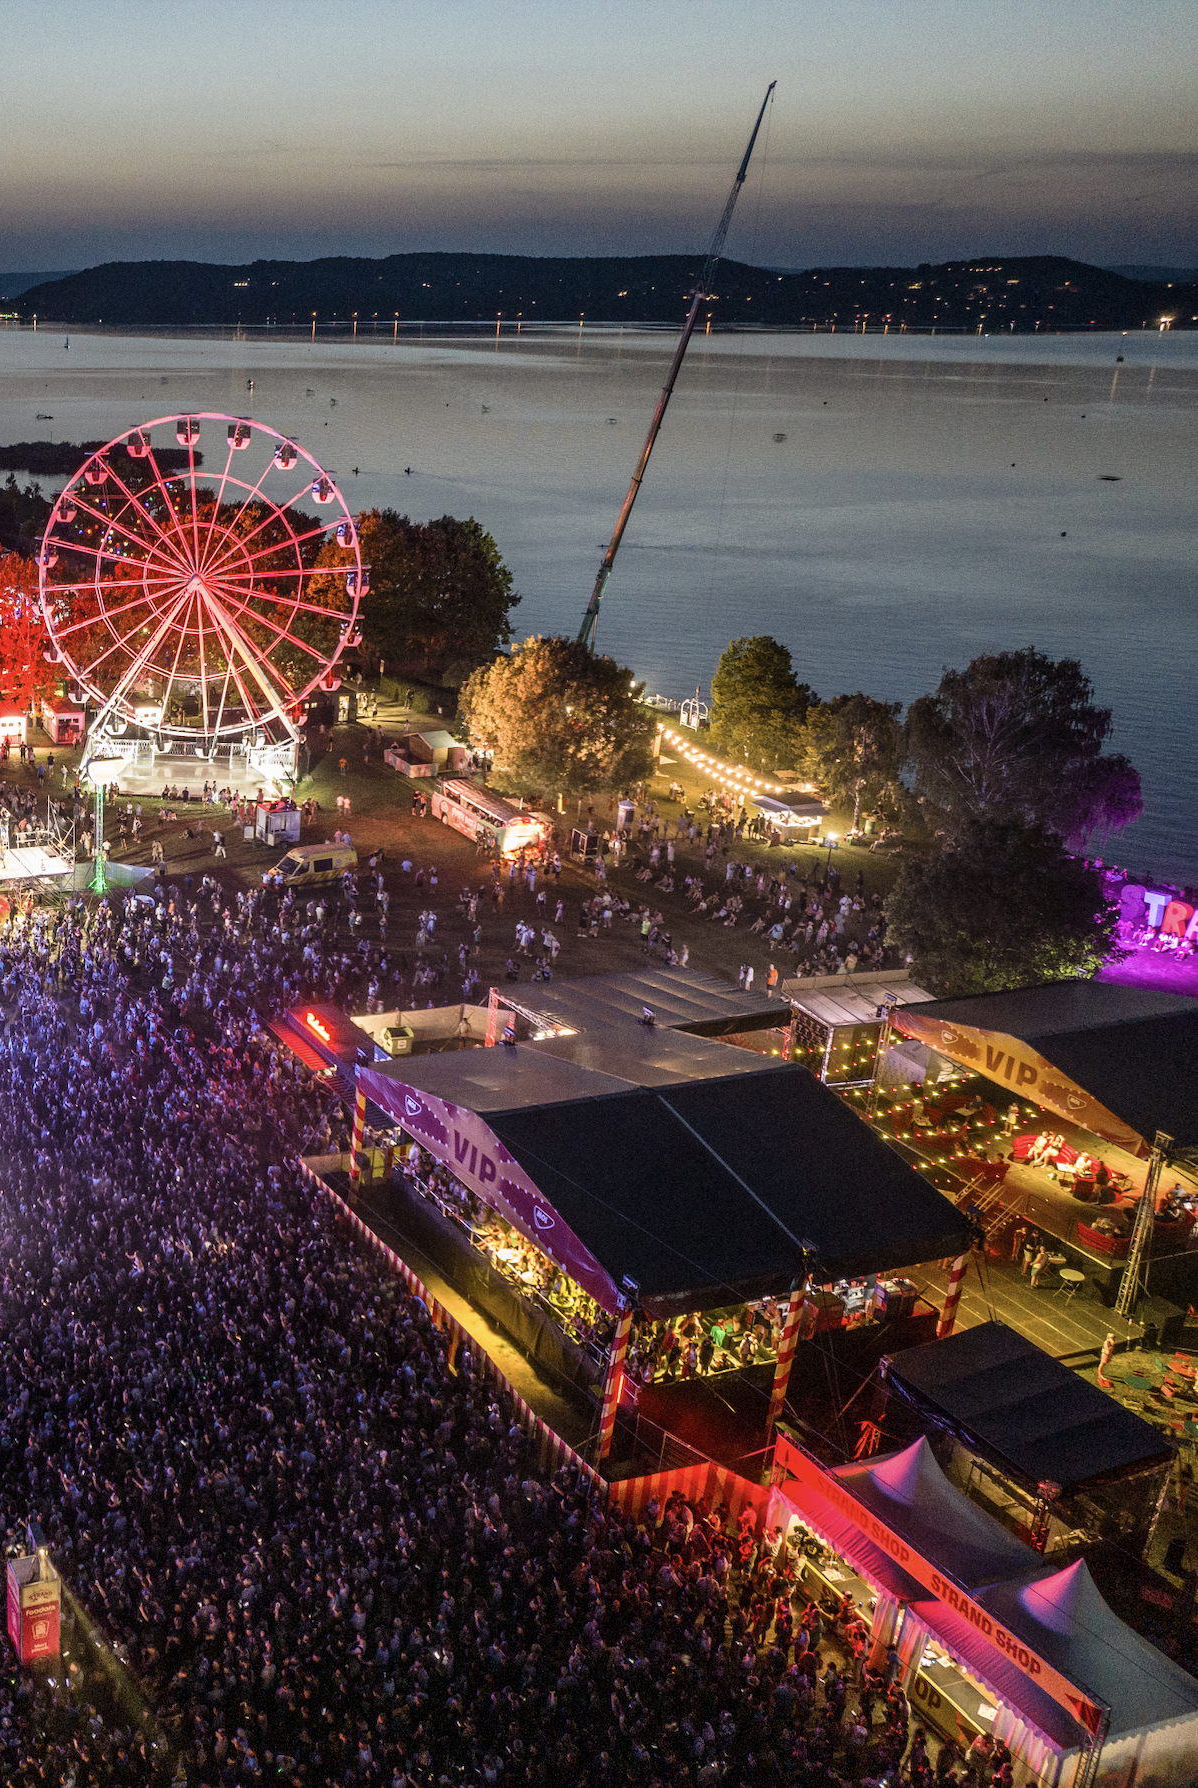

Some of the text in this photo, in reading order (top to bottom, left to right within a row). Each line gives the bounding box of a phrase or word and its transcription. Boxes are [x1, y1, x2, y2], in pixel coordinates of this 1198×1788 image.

[986, 1044, 1038, 1087] VIP
[454, 1129, 497, 1184] VIP
[817, 1475, 910, 1562] STRAND SHOP
[26, 1605, 56, 1616] foodora
[931, 1573, 1041, 1675] STRAND SHOP
